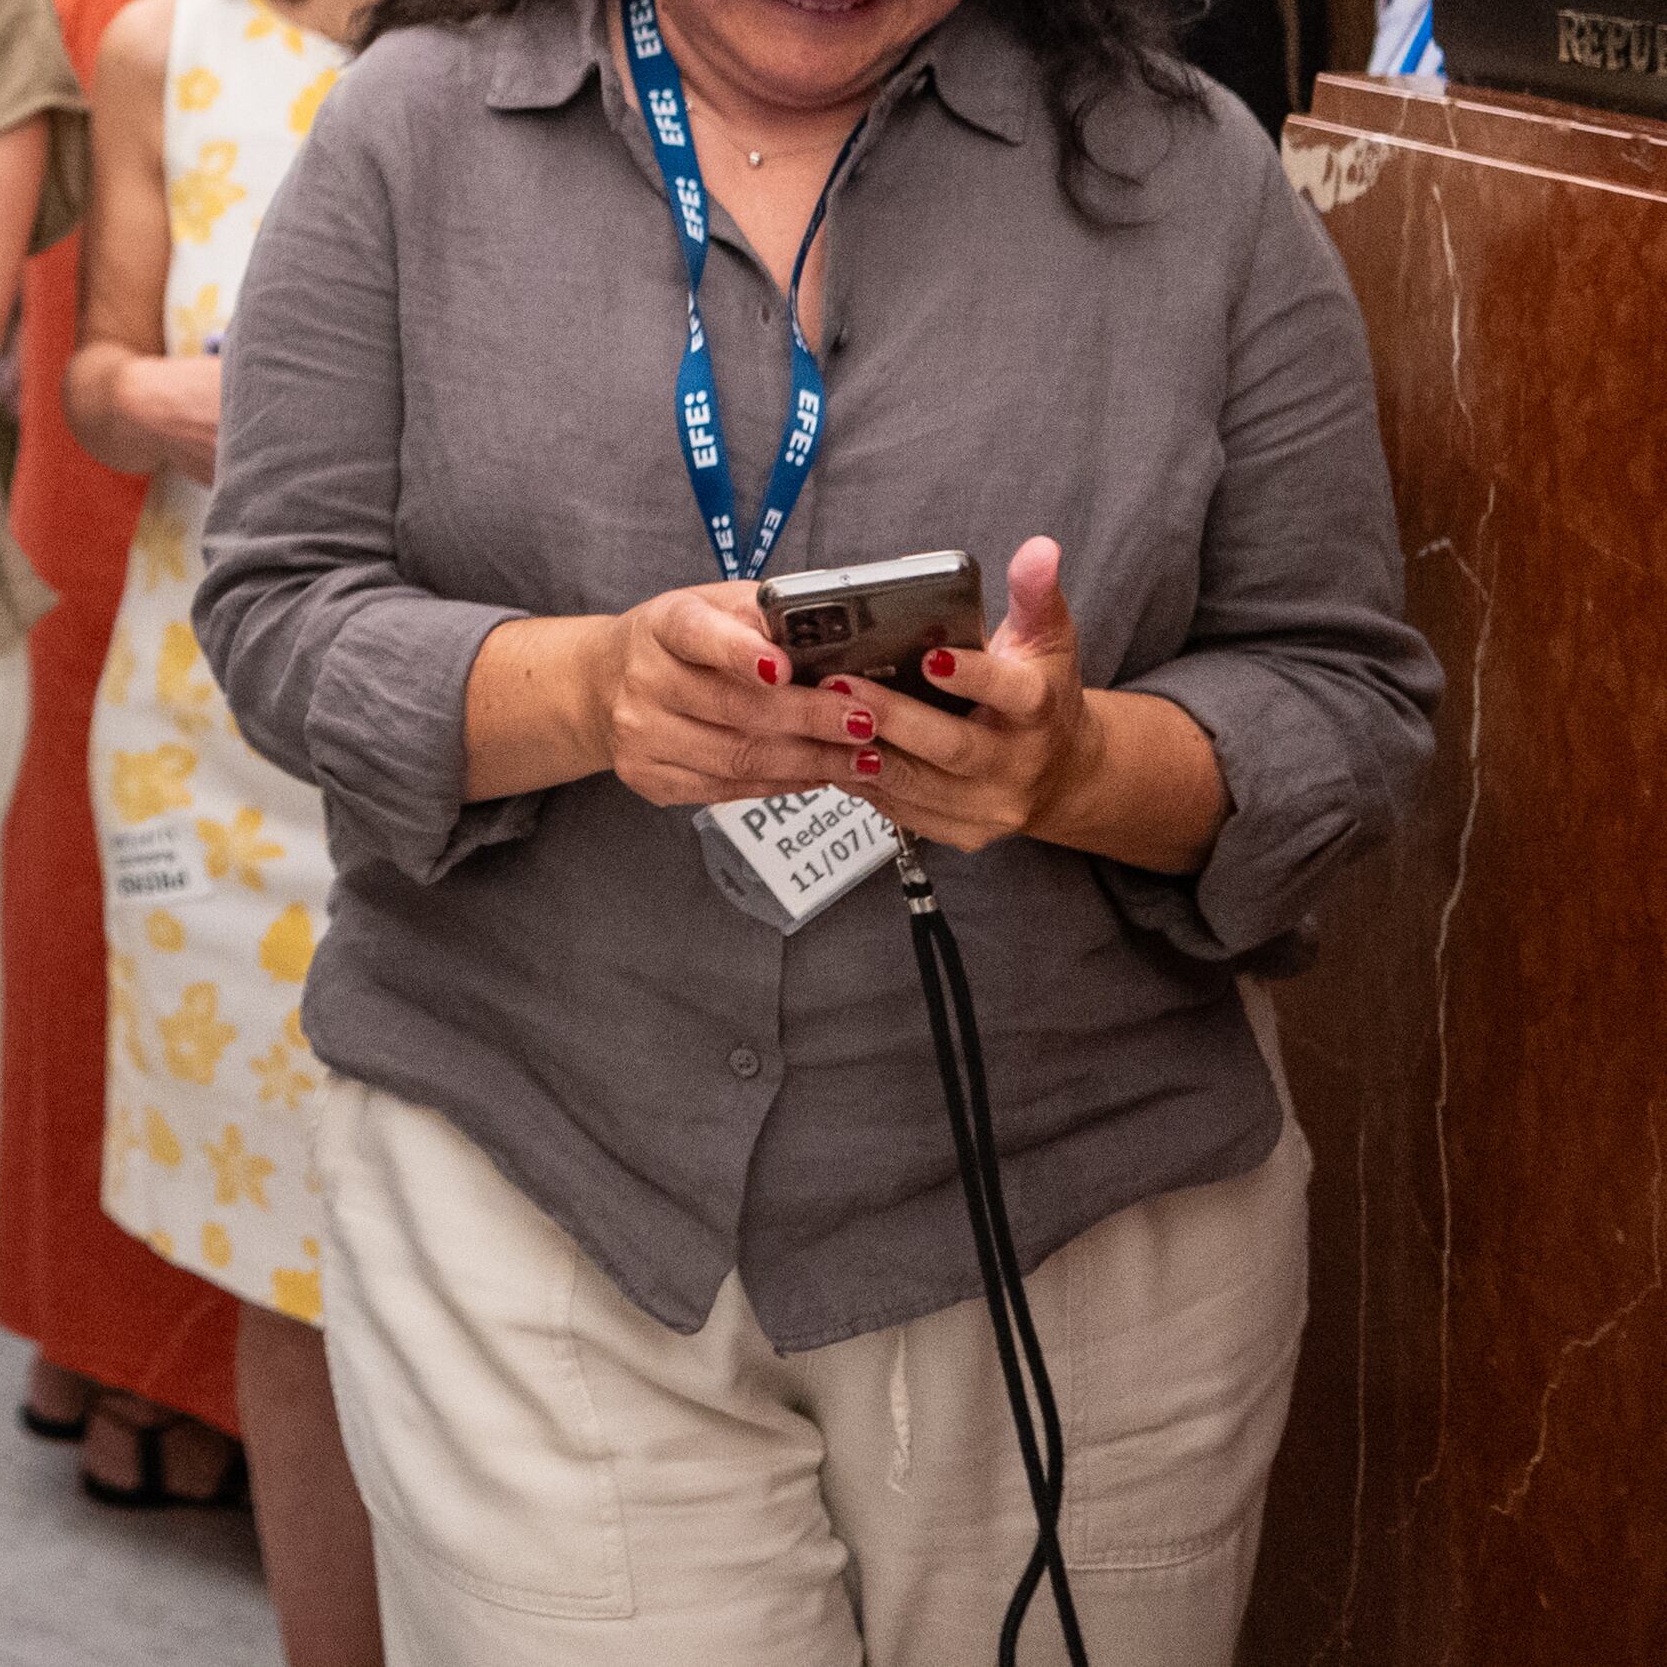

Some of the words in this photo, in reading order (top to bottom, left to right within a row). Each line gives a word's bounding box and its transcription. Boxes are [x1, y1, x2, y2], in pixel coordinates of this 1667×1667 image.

[648, 87, 686, 148] EFE:
[675, 175, 705, 245] EFE:
[684, 389, 720, 470] EFE:
[784, 388, 821, 468] EFE:
